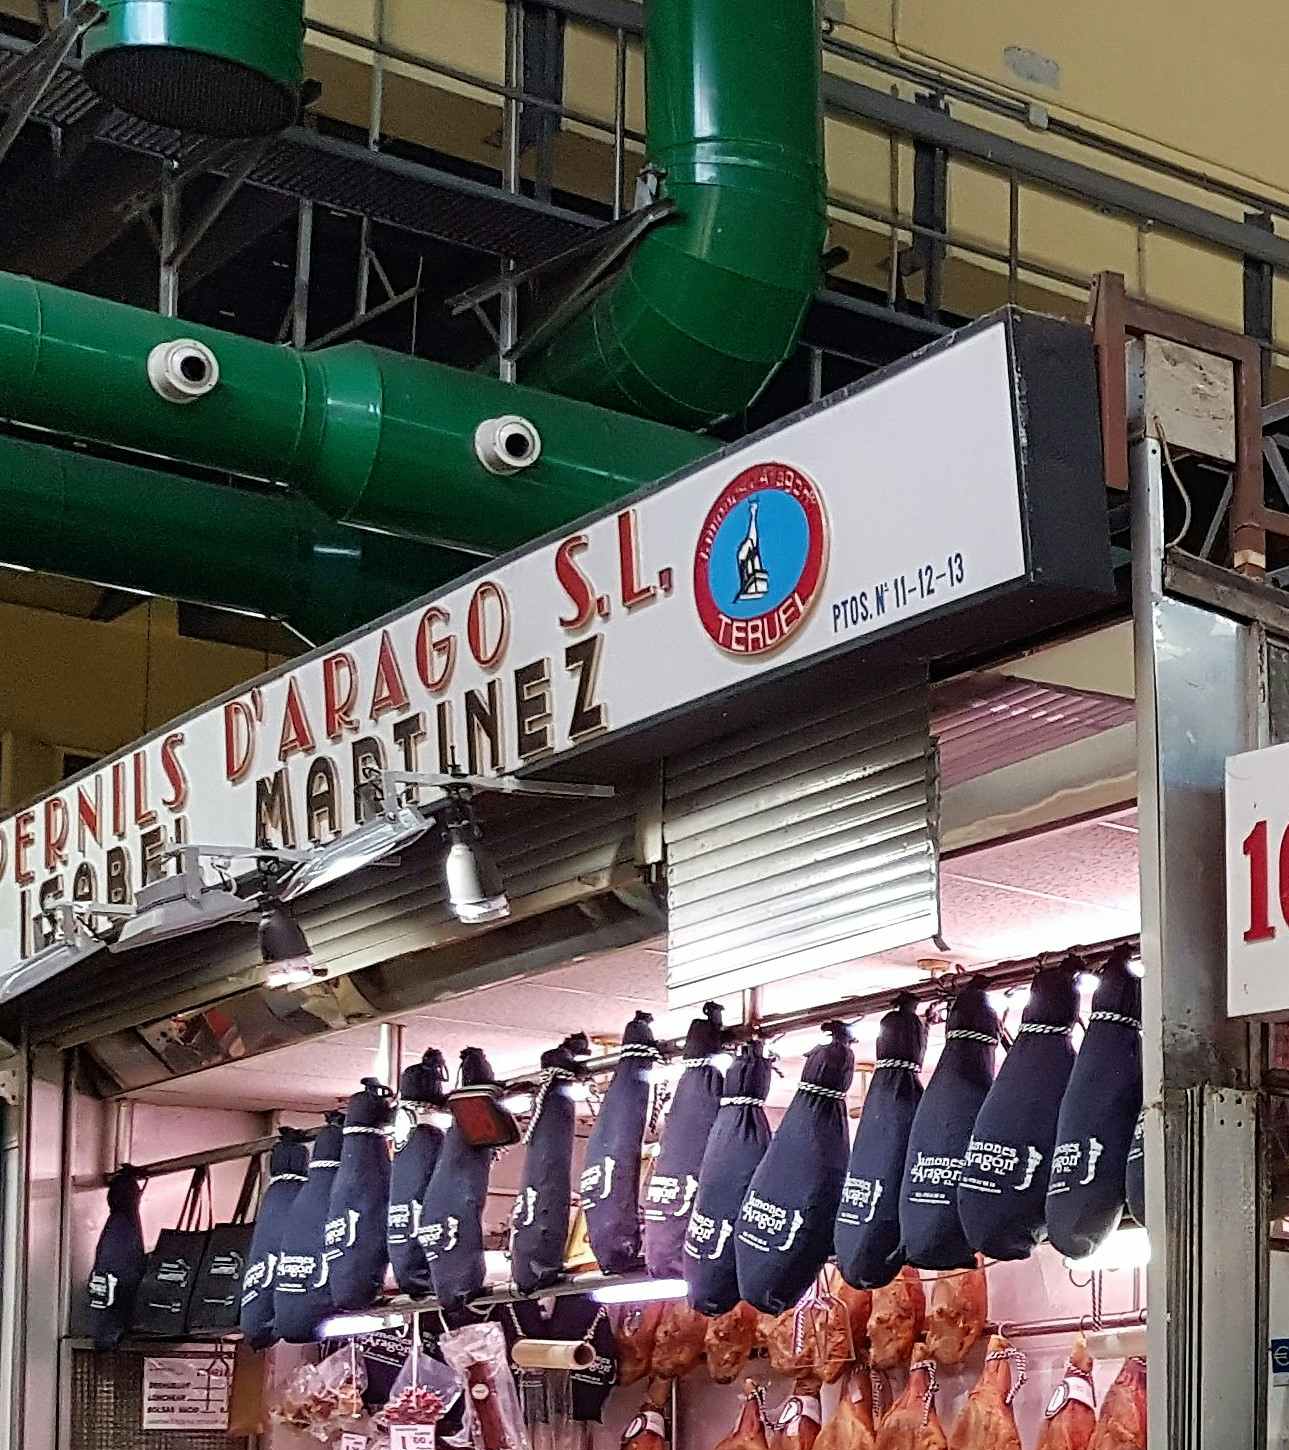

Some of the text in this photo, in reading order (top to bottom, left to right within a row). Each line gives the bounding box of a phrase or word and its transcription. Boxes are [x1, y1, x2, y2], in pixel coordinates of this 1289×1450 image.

[225, 579, 512, 782] D'ARAGO
[554, 508, 674, 632] S.L.
[716, 592, 811, 653] TERUEL
[832, 590, 873, 634] PTOS.
[894, 551, 965, 609] 11-12-13
[254, 634, 609, 850] MARTINEZ
